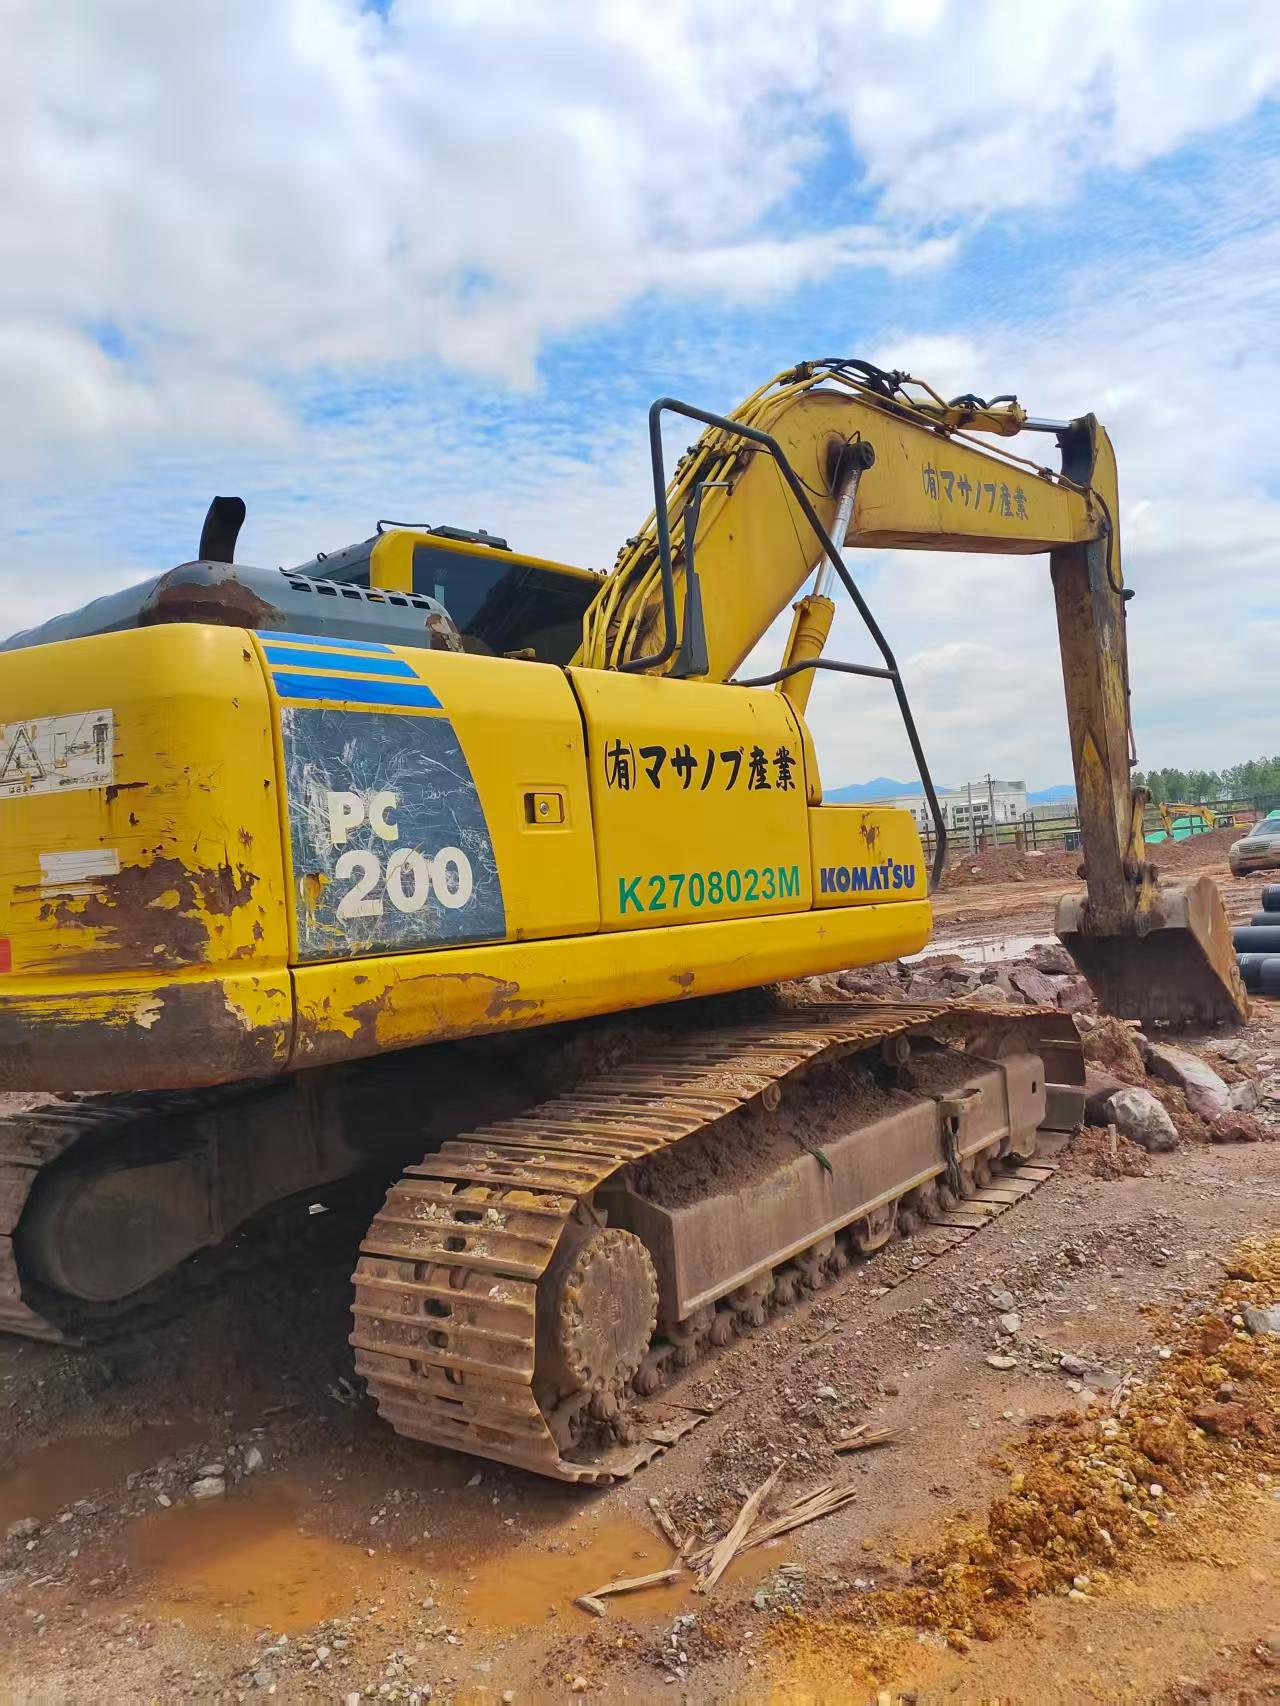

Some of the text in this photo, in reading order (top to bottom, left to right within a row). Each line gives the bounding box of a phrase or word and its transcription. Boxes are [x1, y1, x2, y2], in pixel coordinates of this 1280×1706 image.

[327, 791, 399, 844] PC
[336, 847, 473, 917] 200
[618, 866, 801, 914] K2708023M
[820, 858, 916, 893] KOMATSU
